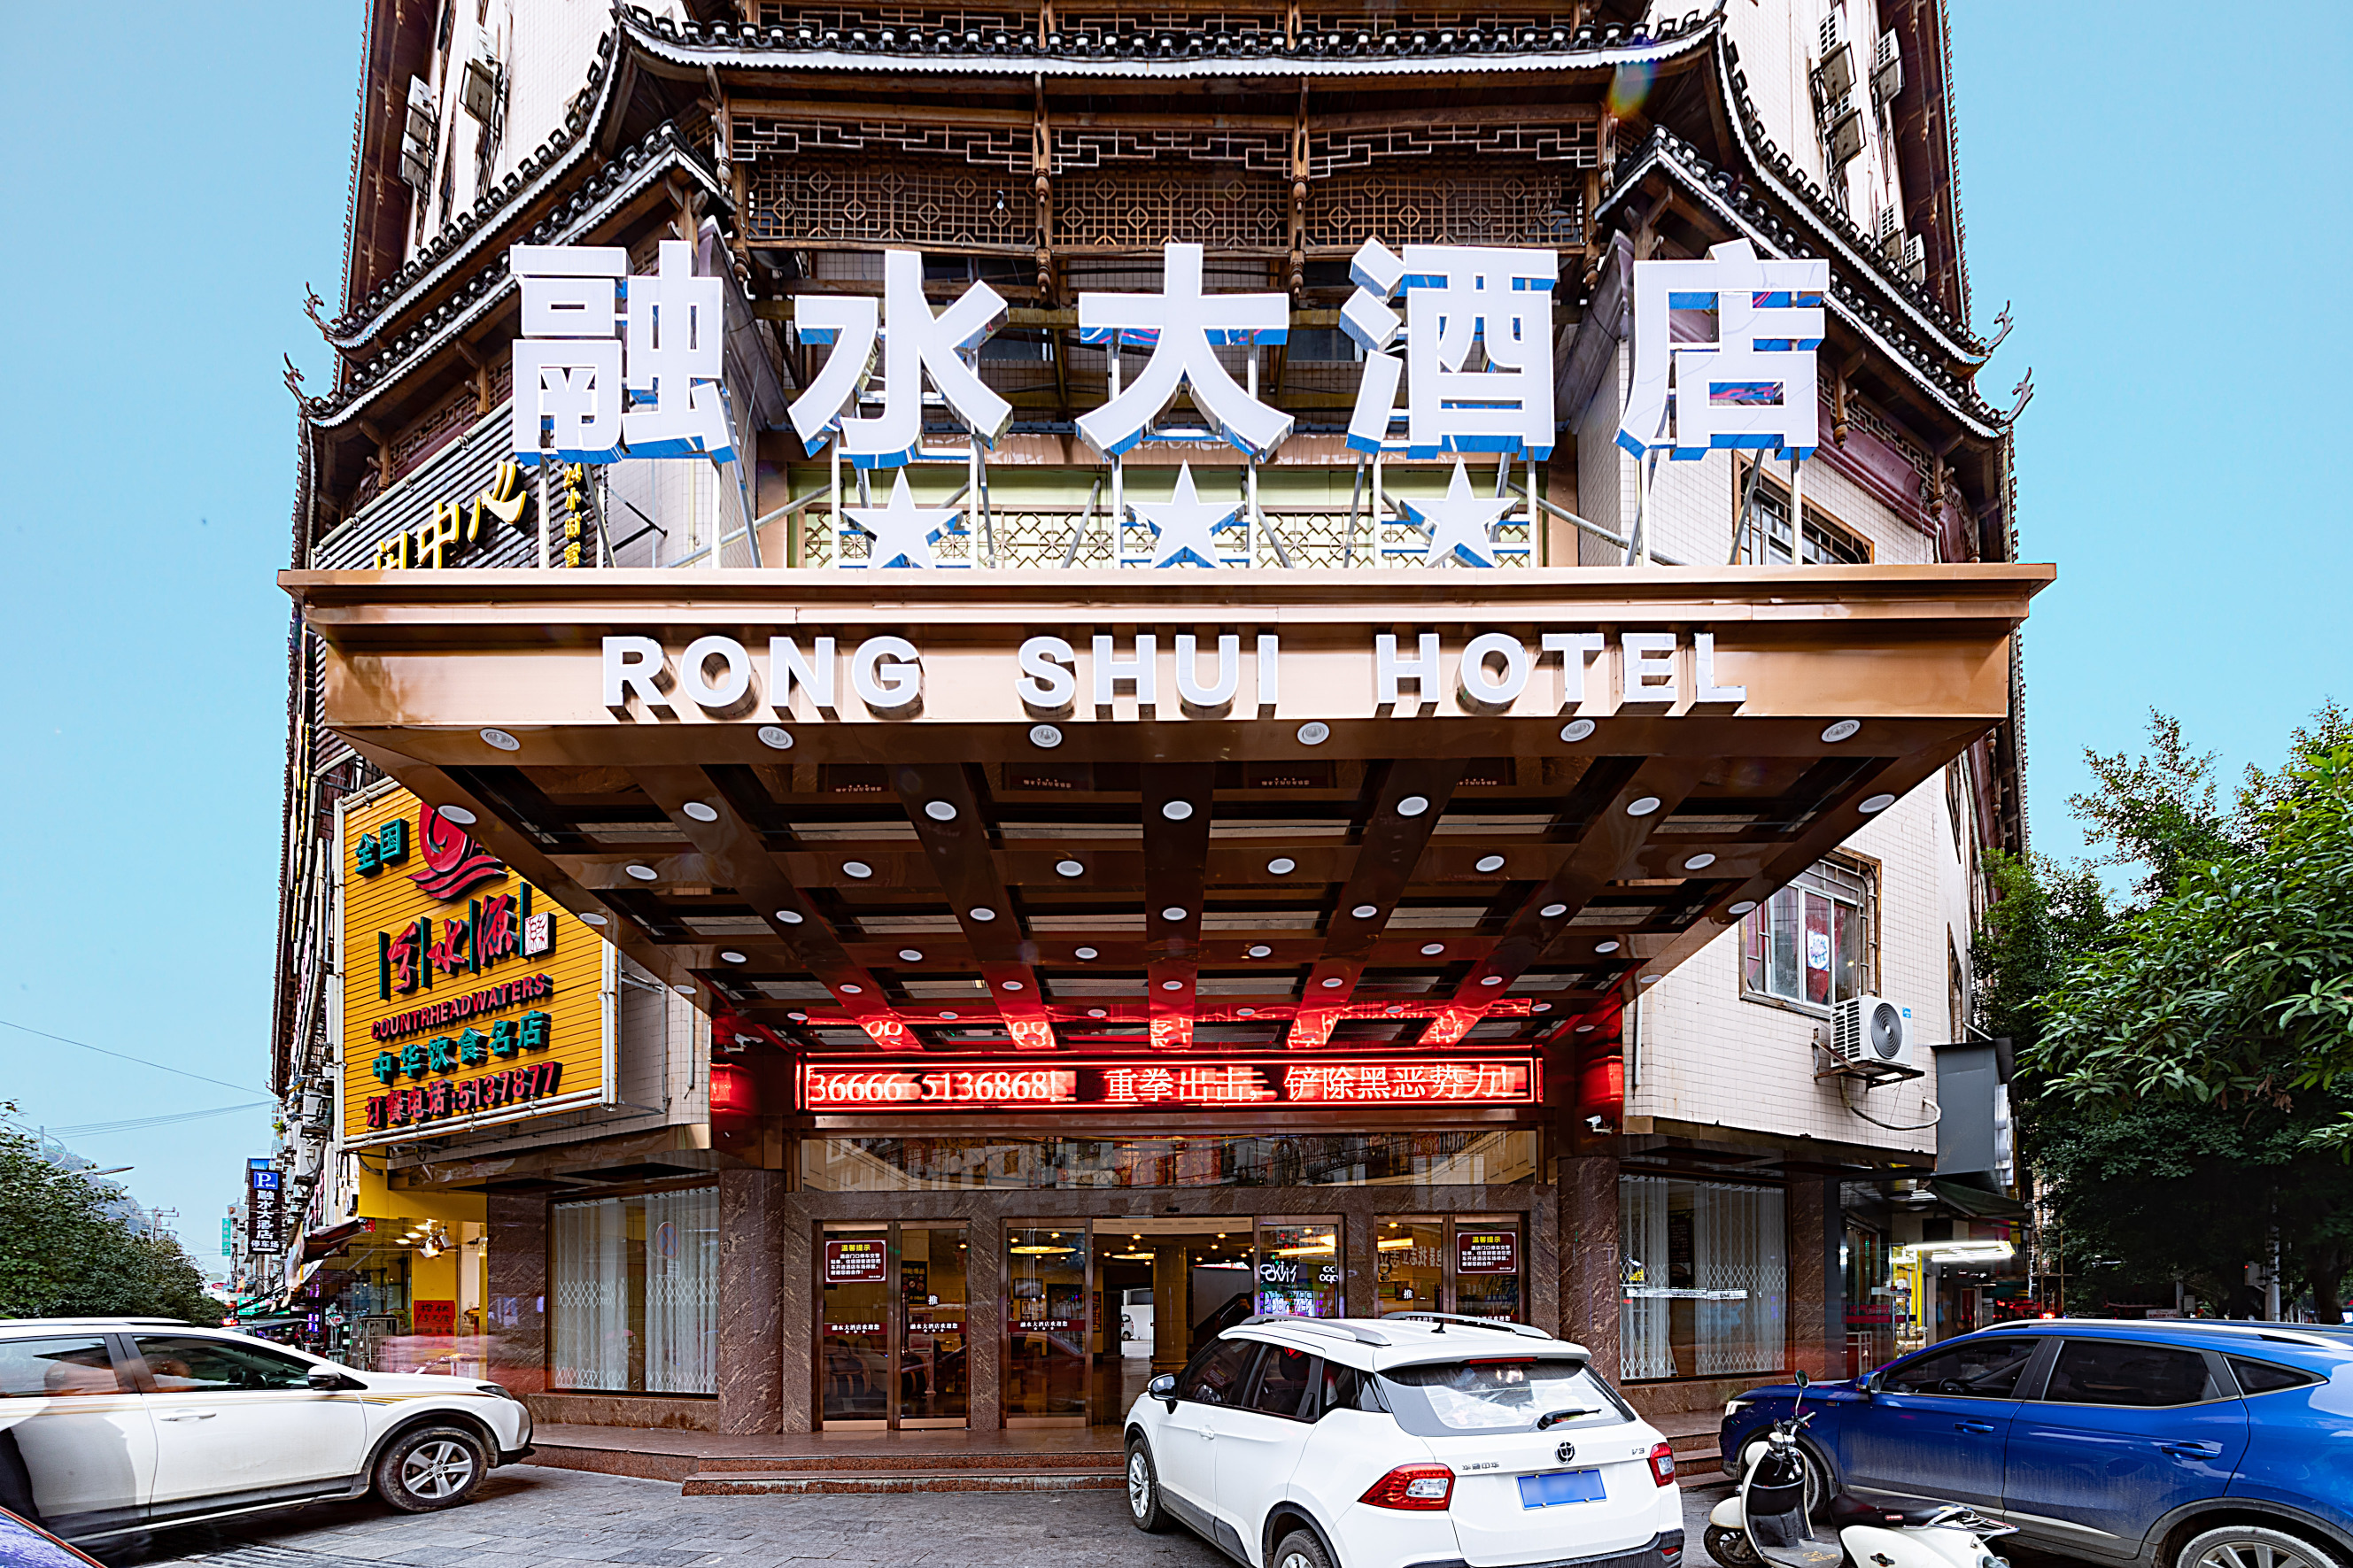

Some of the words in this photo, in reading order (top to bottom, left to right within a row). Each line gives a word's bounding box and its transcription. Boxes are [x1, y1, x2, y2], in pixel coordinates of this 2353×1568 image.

[509, 238, 1831, 455] 融水大酒店
[602, 635, 922, 708] RONG
[1014, 634, 1279, 707] SHUI
[1374, 632, 1747, 704] HOTEL
[370, 973, 546, 1040] COUNTRHEADWATERS
[372, 1009, 544, 1084] 中华饮食名店
[256, 1172, 272, 1187] P
[256, 1189, 275, 1240] 融水大酒店
[251, 1240, 280, 1248] 停车场
[928, 1294, 939, 1306] 推
[1403, 1289, 1413, 1300] 推
[1631, 1447, 1645, 1456] V3
